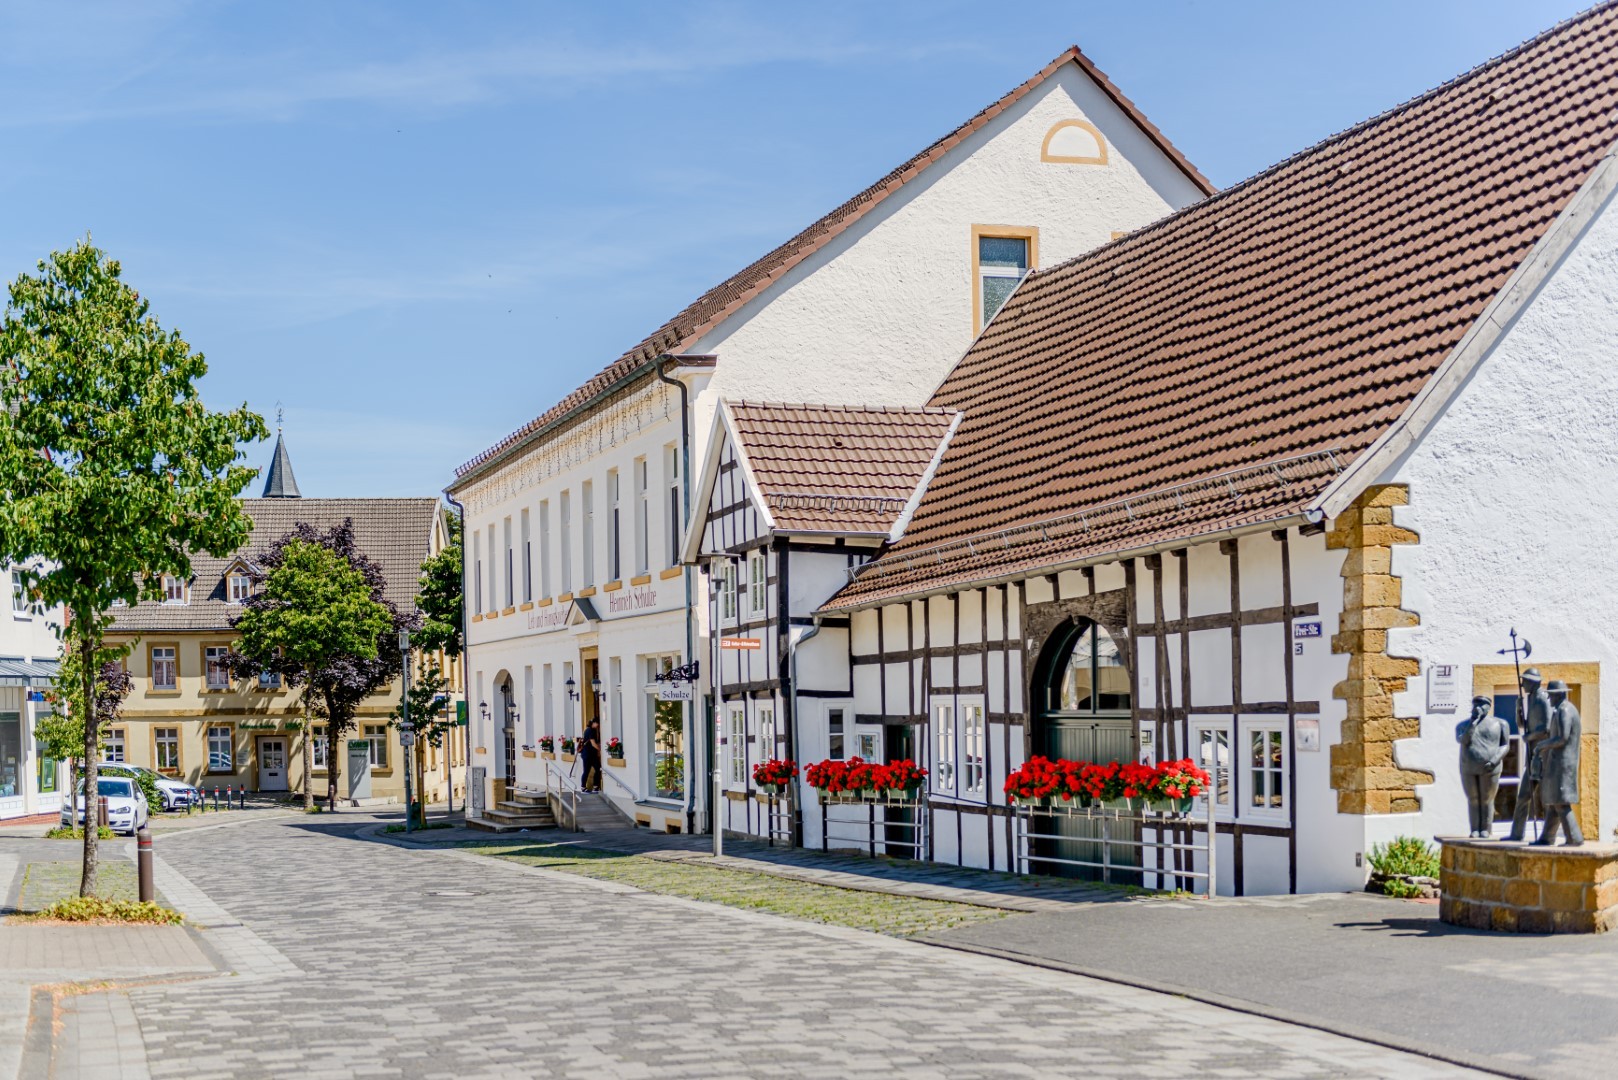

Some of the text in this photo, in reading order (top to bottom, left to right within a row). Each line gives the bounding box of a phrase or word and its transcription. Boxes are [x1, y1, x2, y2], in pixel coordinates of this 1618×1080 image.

[609, 585, 657, 613] Heinrich Schulze
[662, 690, 690, 699] Schulze
